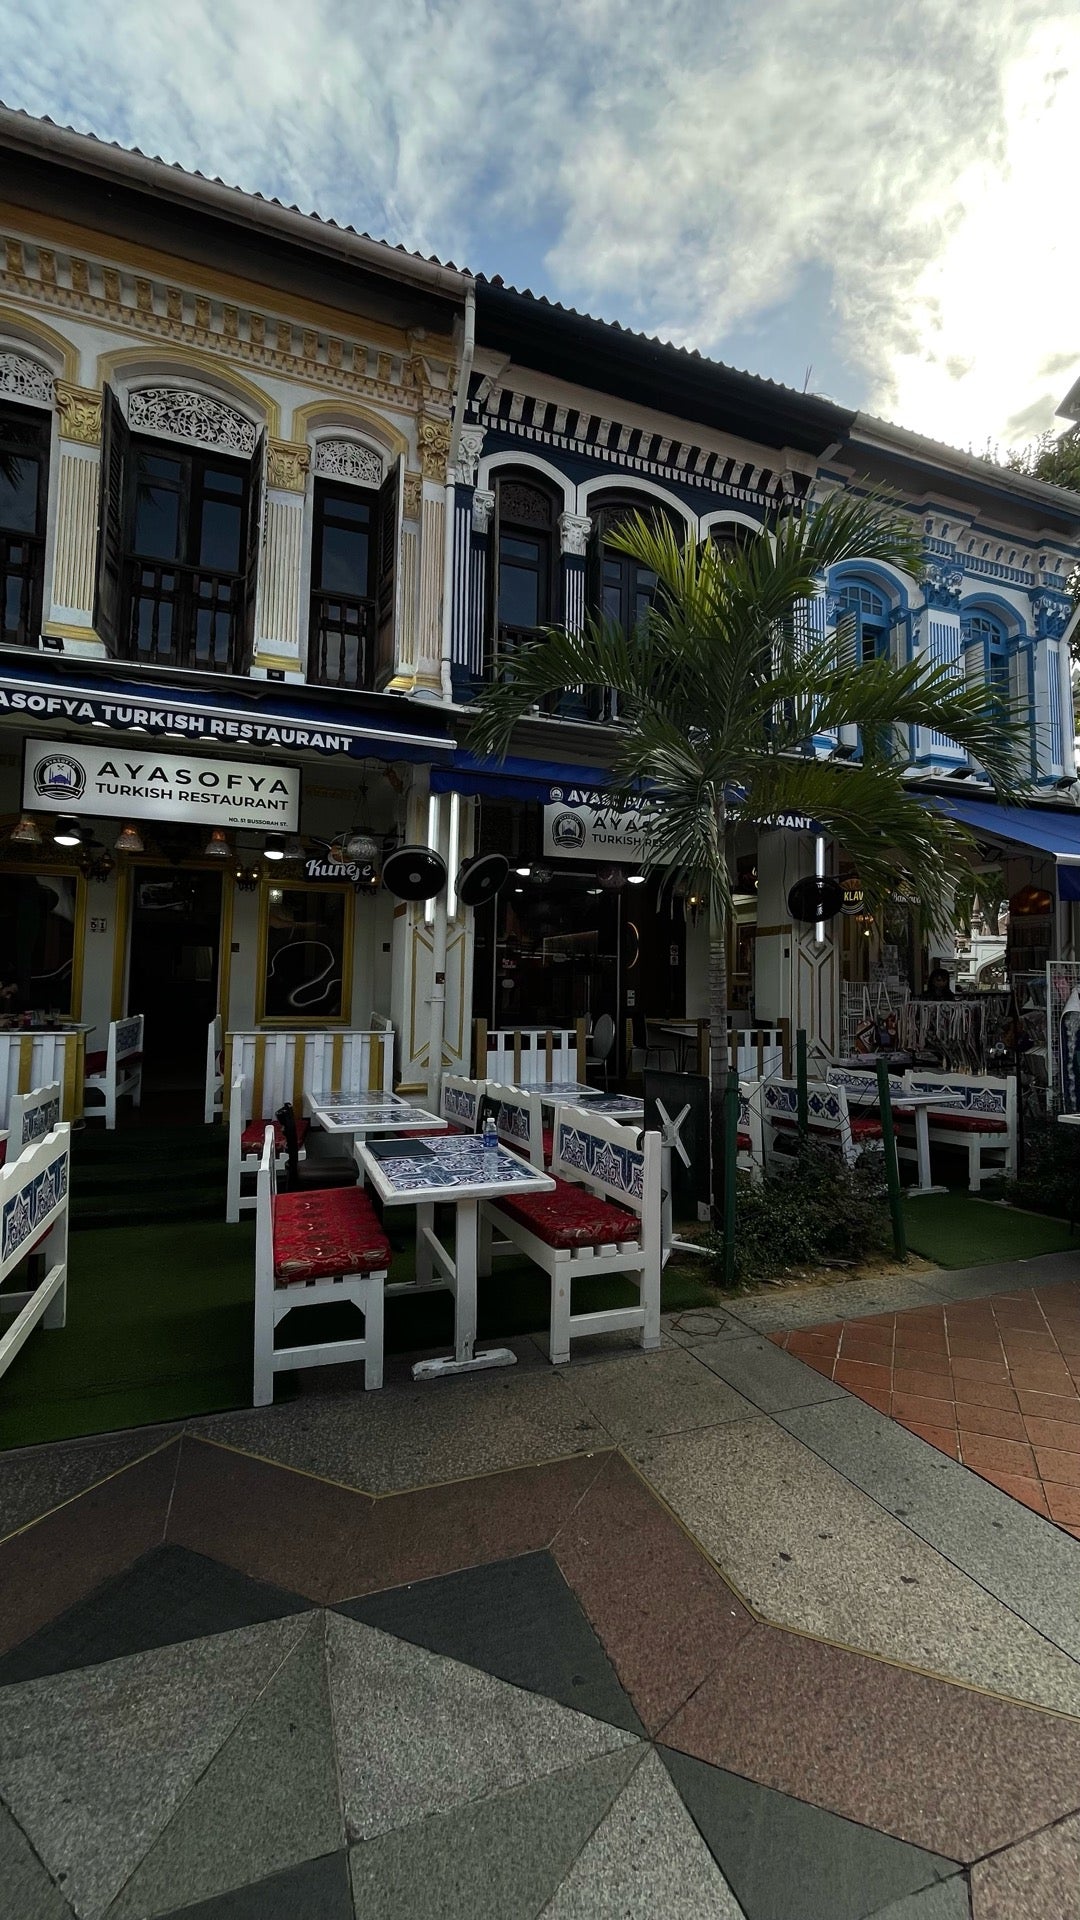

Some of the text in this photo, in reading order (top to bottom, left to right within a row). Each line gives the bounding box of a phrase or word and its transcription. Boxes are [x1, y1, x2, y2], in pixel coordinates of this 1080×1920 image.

[101, 705, 205, 732] TURKISH
[210, 719, 353, 751] RESTAURANT
[97, 761, 290, 795] AYASOFYA
[95, 782, 289, 811] TURKISH RESTAURANT
[247, 818, 279, 826] BUSSORAH
[592, 833, 641, 847] TURKISH
[843, 890, 864, 902] KLAV
